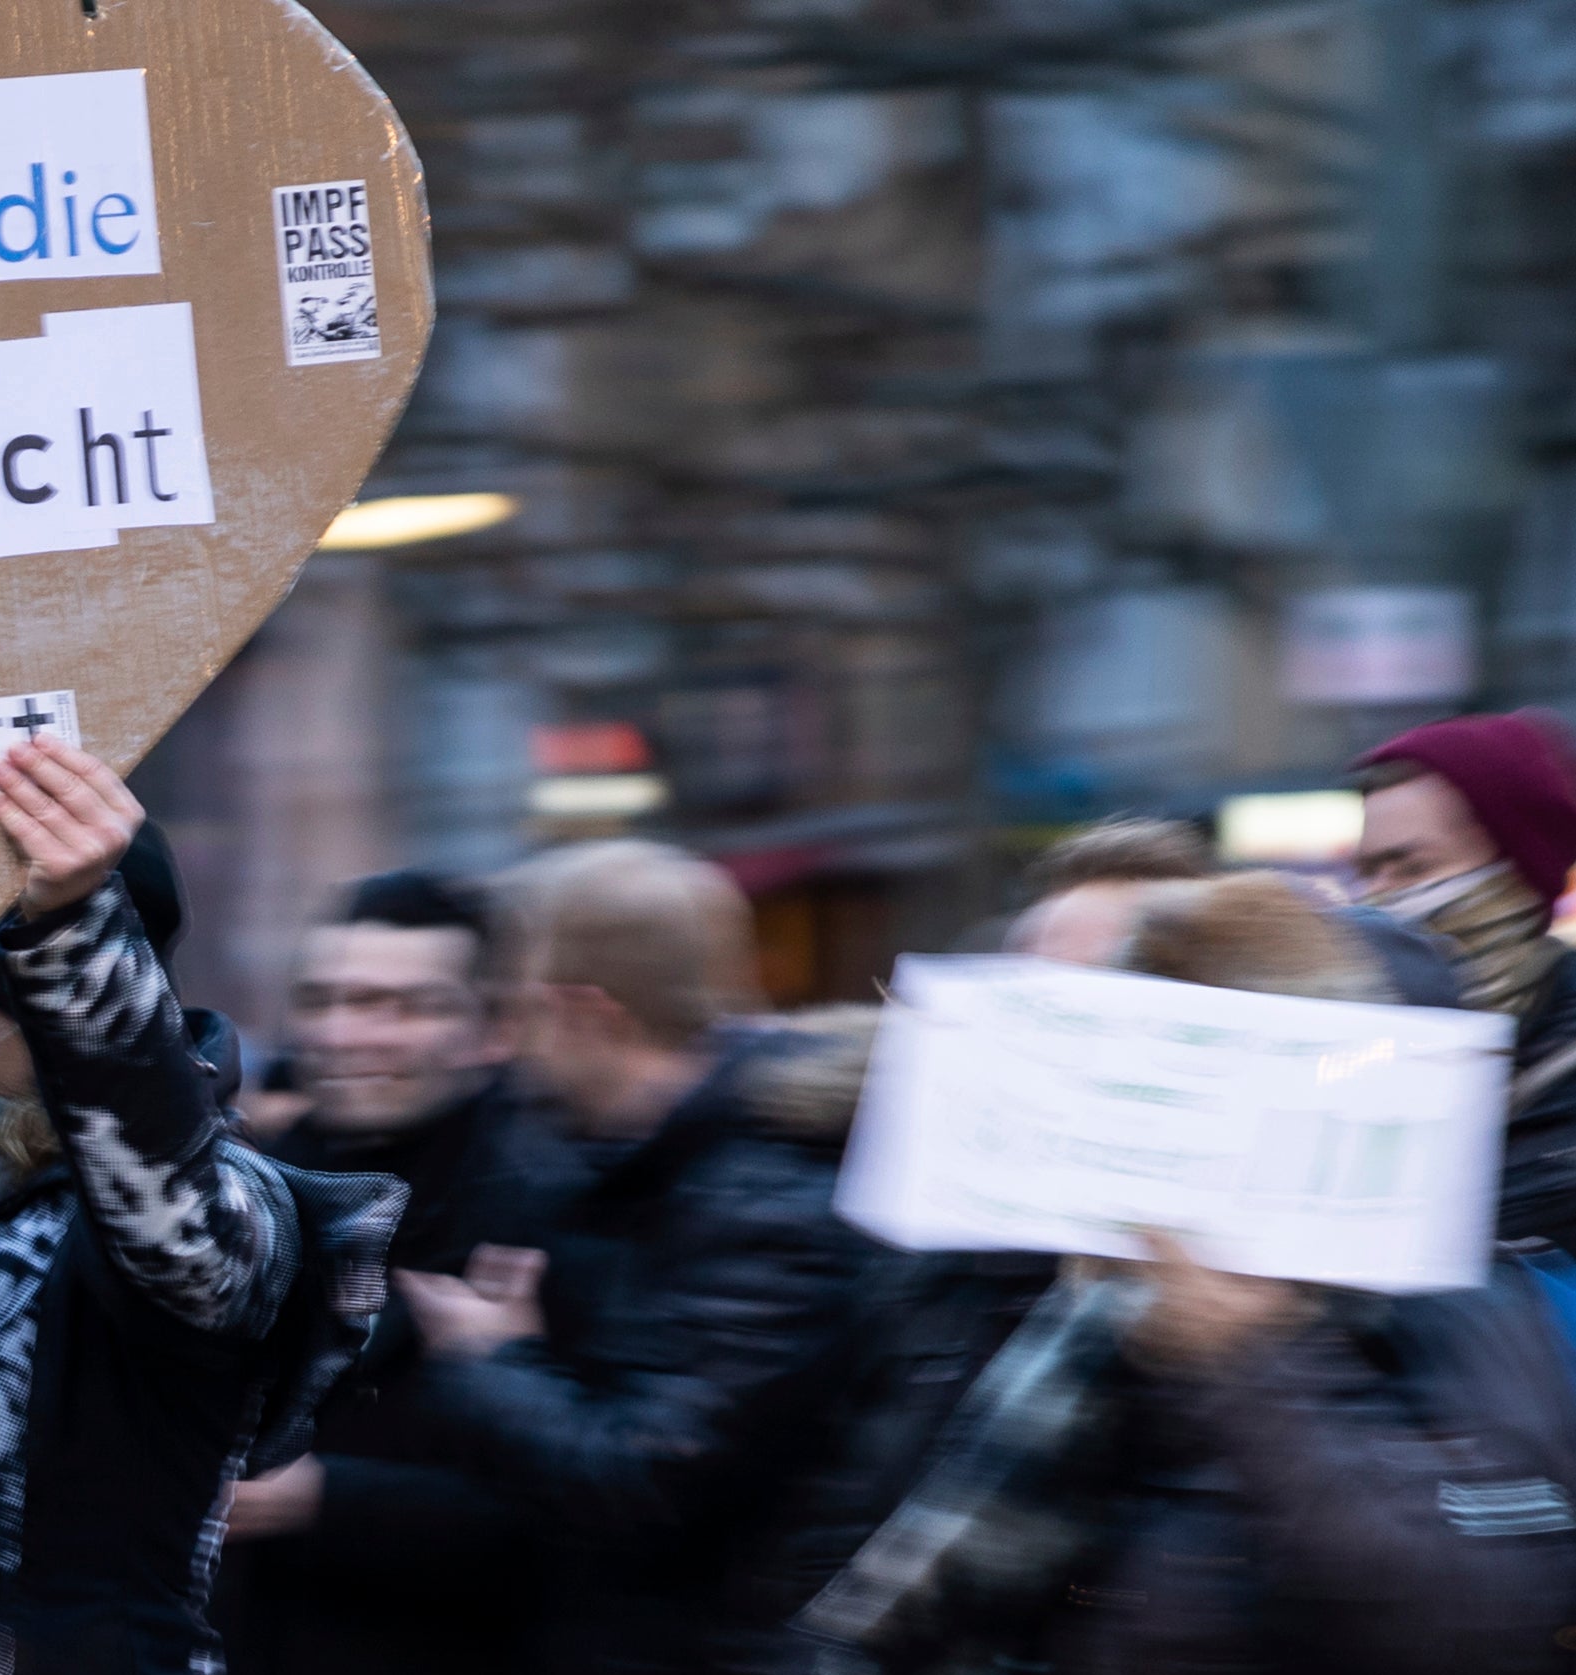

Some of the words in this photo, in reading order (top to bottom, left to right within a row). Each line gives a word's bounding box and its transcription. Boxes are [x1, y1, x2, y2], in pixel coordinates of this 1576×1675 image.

[280, 185, 366, 227] IMPF
[285, 223, 370, 264] PASS
[288, 259, 373, 283] KONTROLLE
